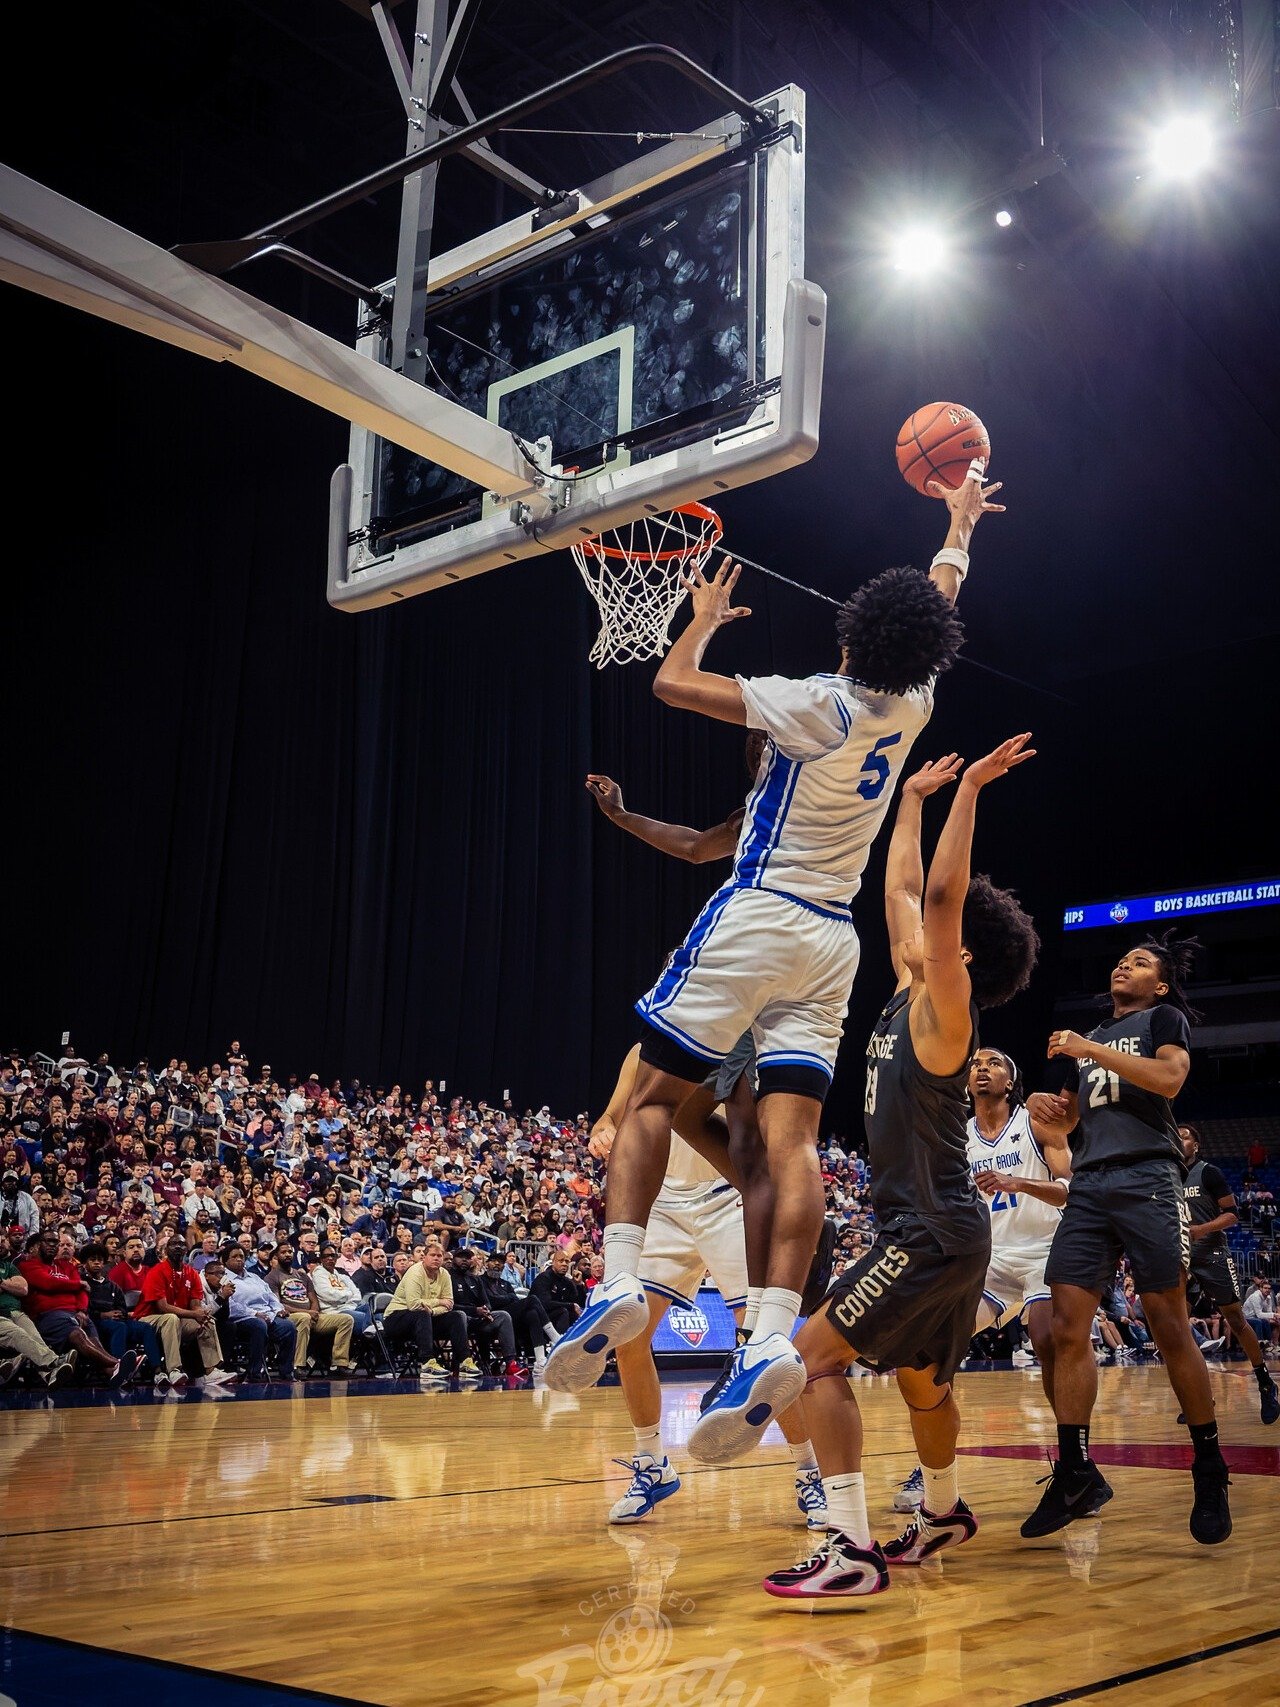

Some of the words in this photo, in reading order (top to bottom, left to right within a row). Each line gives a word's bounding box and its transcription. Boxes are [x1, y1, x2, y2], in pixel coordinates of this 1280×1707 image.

[857, 731, 903, 800] 5
[1154, 898, 1183, 913] BOYS
[1185, 888, 1254, 909] BASKETBALL
[1087, 1066, 1120, 1109] 21
[971, 1157, 993, 1174] WEST
[996, 1151, 1023, 1170] BROOK
[1183, 1186, 1201, 1198] AGE
[835, 1245, 910, 1328] COYOTES
[671, 1316, 708, 1329] STATE
